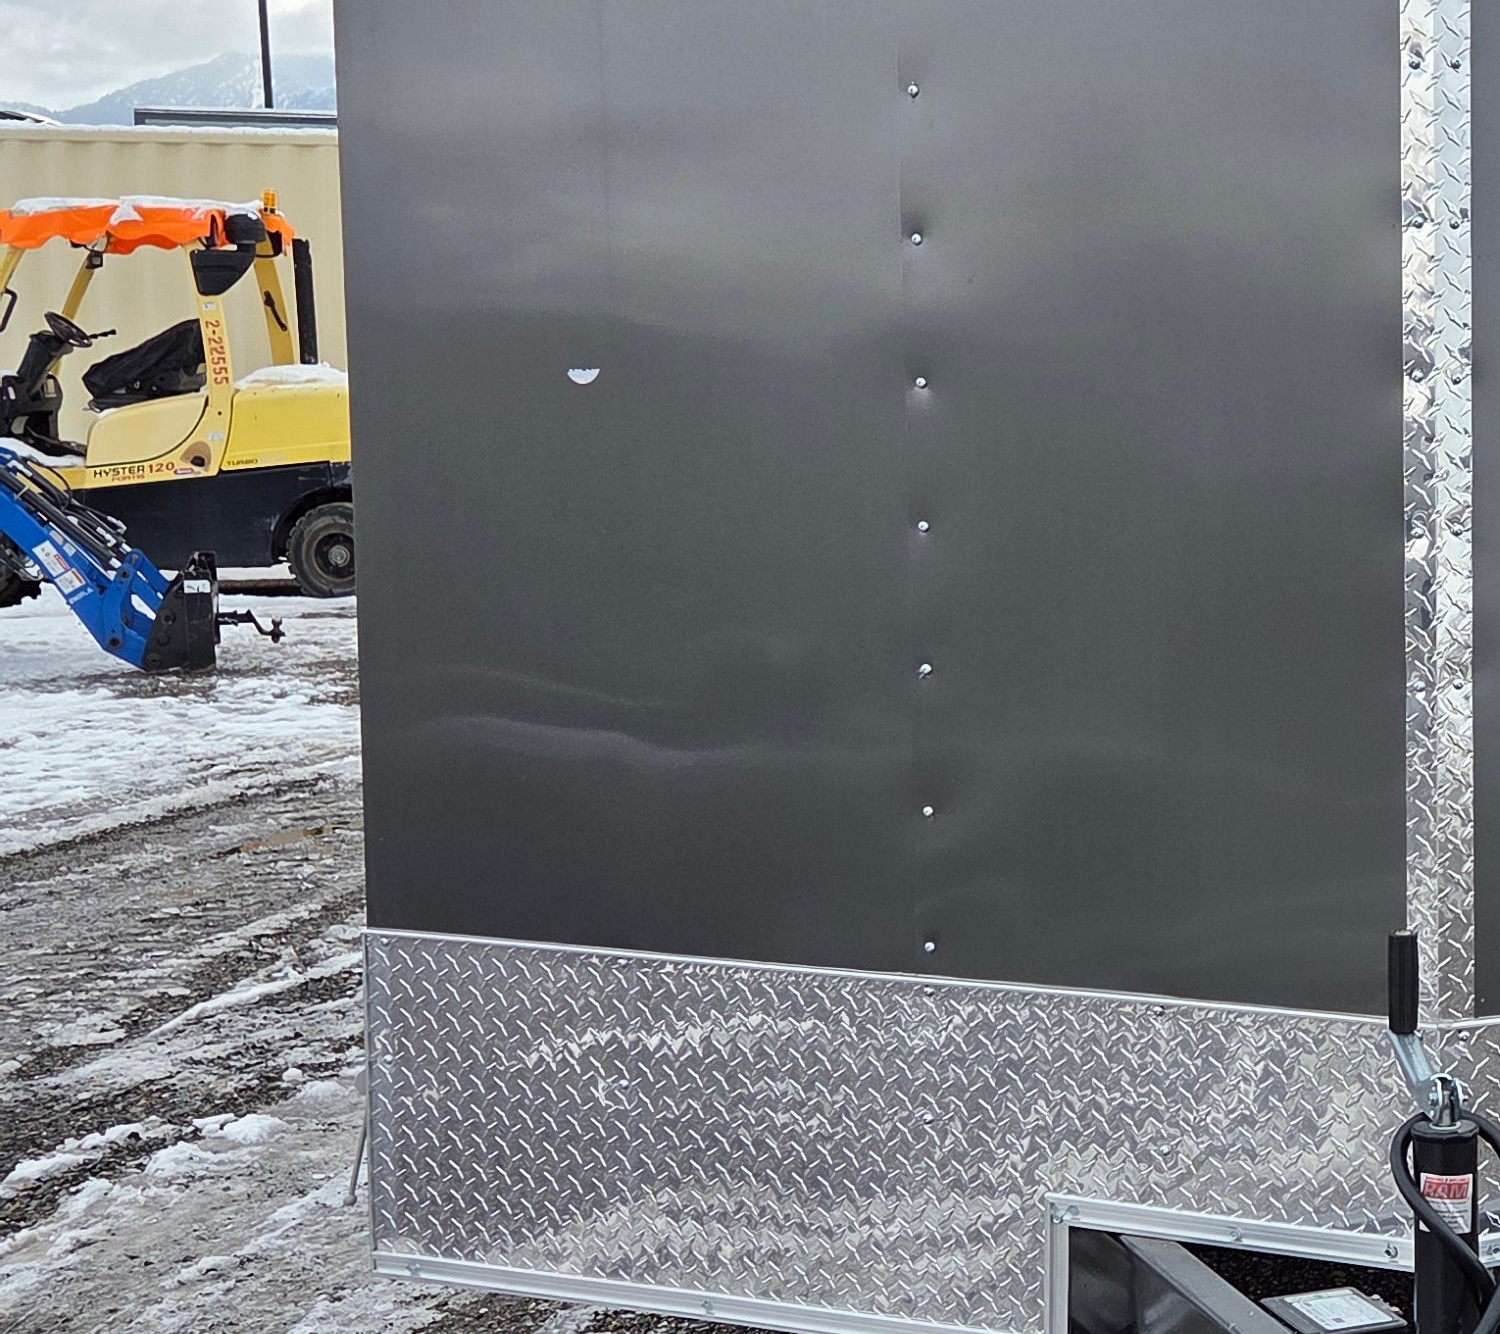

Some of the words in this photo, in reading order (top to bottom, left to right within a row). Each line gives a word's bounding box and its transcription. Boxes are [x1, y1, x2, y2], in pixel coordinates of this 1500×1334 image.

[204, 319, 230, 386] 2-22555
[93, 464, 145, 478] HYSTER
[148, 461, 175, 474] 120
[1424, 1182, 1469, 1199] RAM
